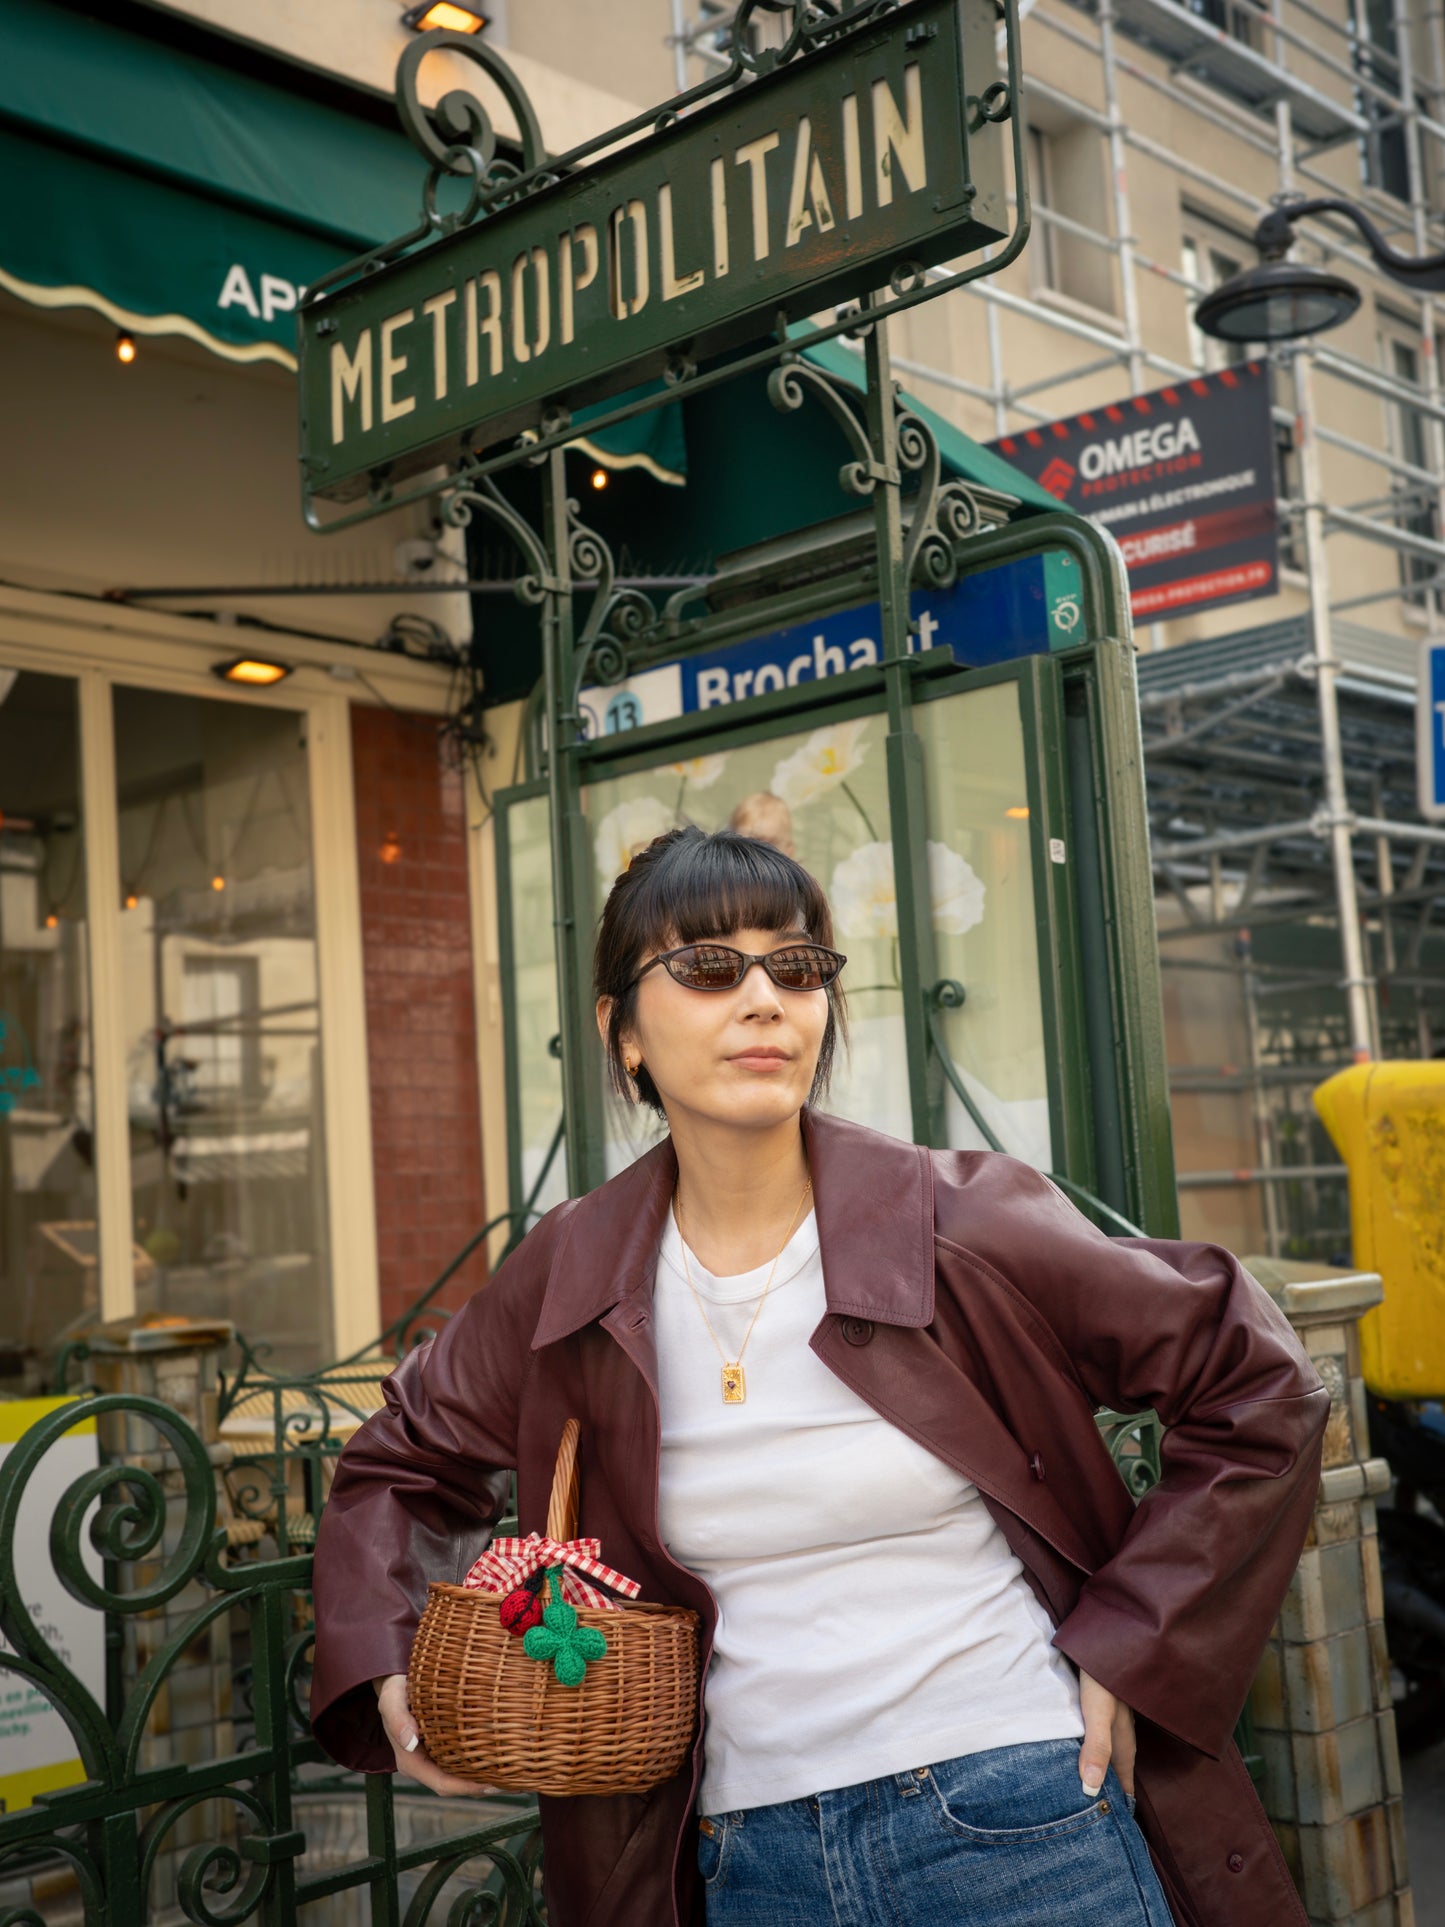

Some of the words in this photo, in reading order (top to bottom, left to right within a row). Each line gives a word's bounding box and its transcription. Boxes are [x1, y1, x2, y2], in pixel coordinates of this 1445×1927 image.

[331, 62, 928, 444] METROPOLITAIN
[1079, 417, 1200, 480] OMEGA
[1081, 452, 1203, 498] PROTECTION
[1150, 468, 1256, 512] ÉLECTRONIQUE
[696, 610, 940, 711] Brochat
[608, 701, 638, 736] 13
